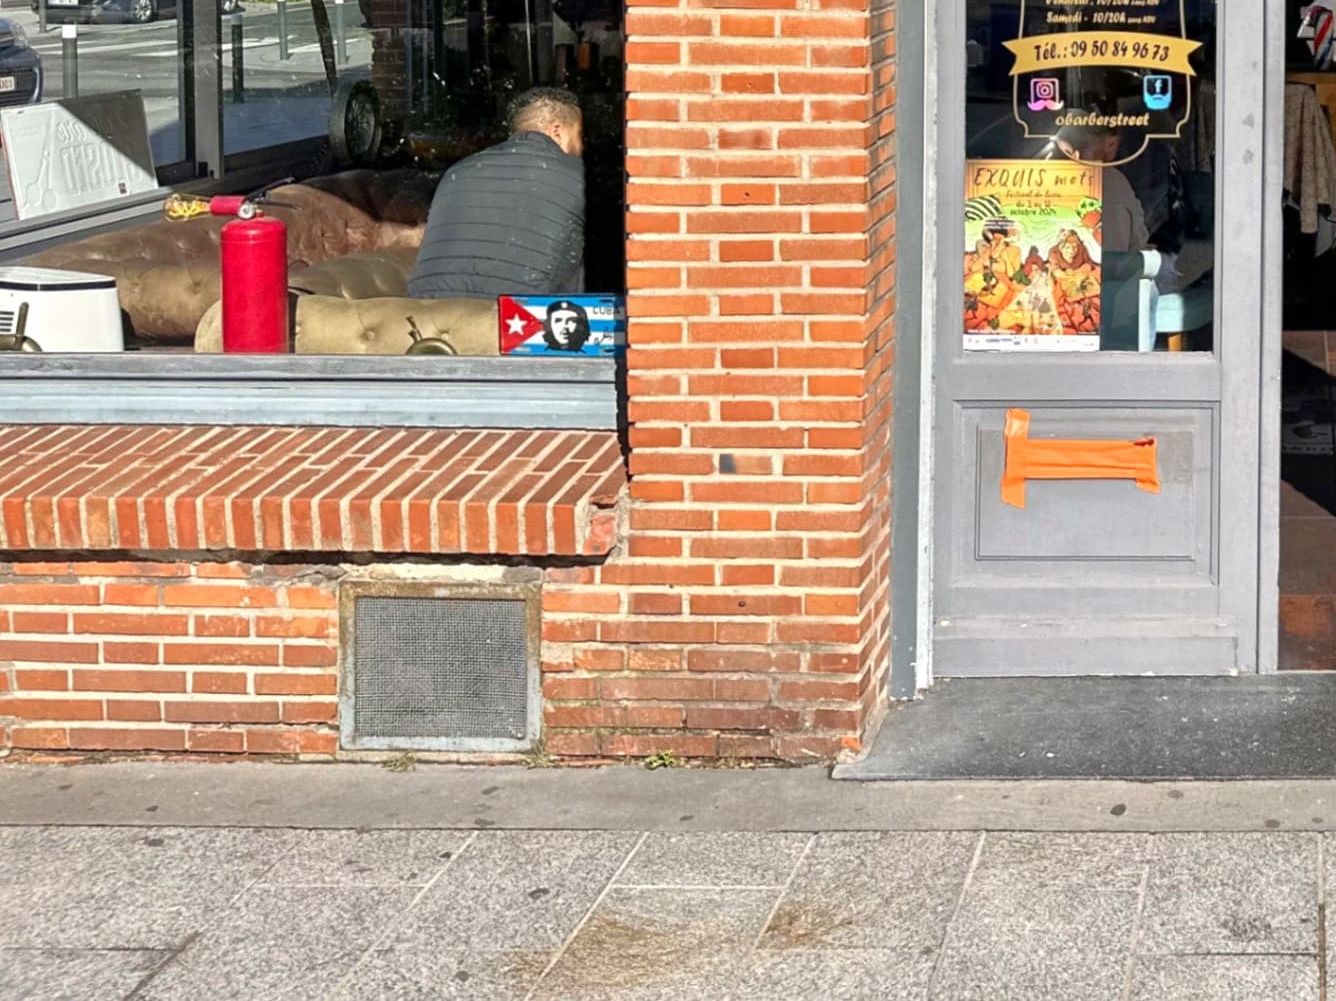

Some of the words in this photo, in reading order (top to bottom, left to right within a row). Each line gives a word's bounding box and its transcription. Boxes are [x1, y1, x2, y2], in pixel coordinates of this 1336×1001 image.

[1046, 11, 1082, 24] Samedi
[1071, 40, 1087, 57] 09
[1091, 40, 1108, 57] 50
[1112, 40, 1128, 57] 84
[1132, 42, 1149, 59] 96
[1151, 44, 1170, 62] 73
[1055, 112, 1150, 128] obarberstreet
[974, 167, 1047, 188] EXQUIS
[1054, 171, 1095, 187] mots
[1010, 208, 1037, 216] octobre
[592, 305, 620, 316] CUBA
